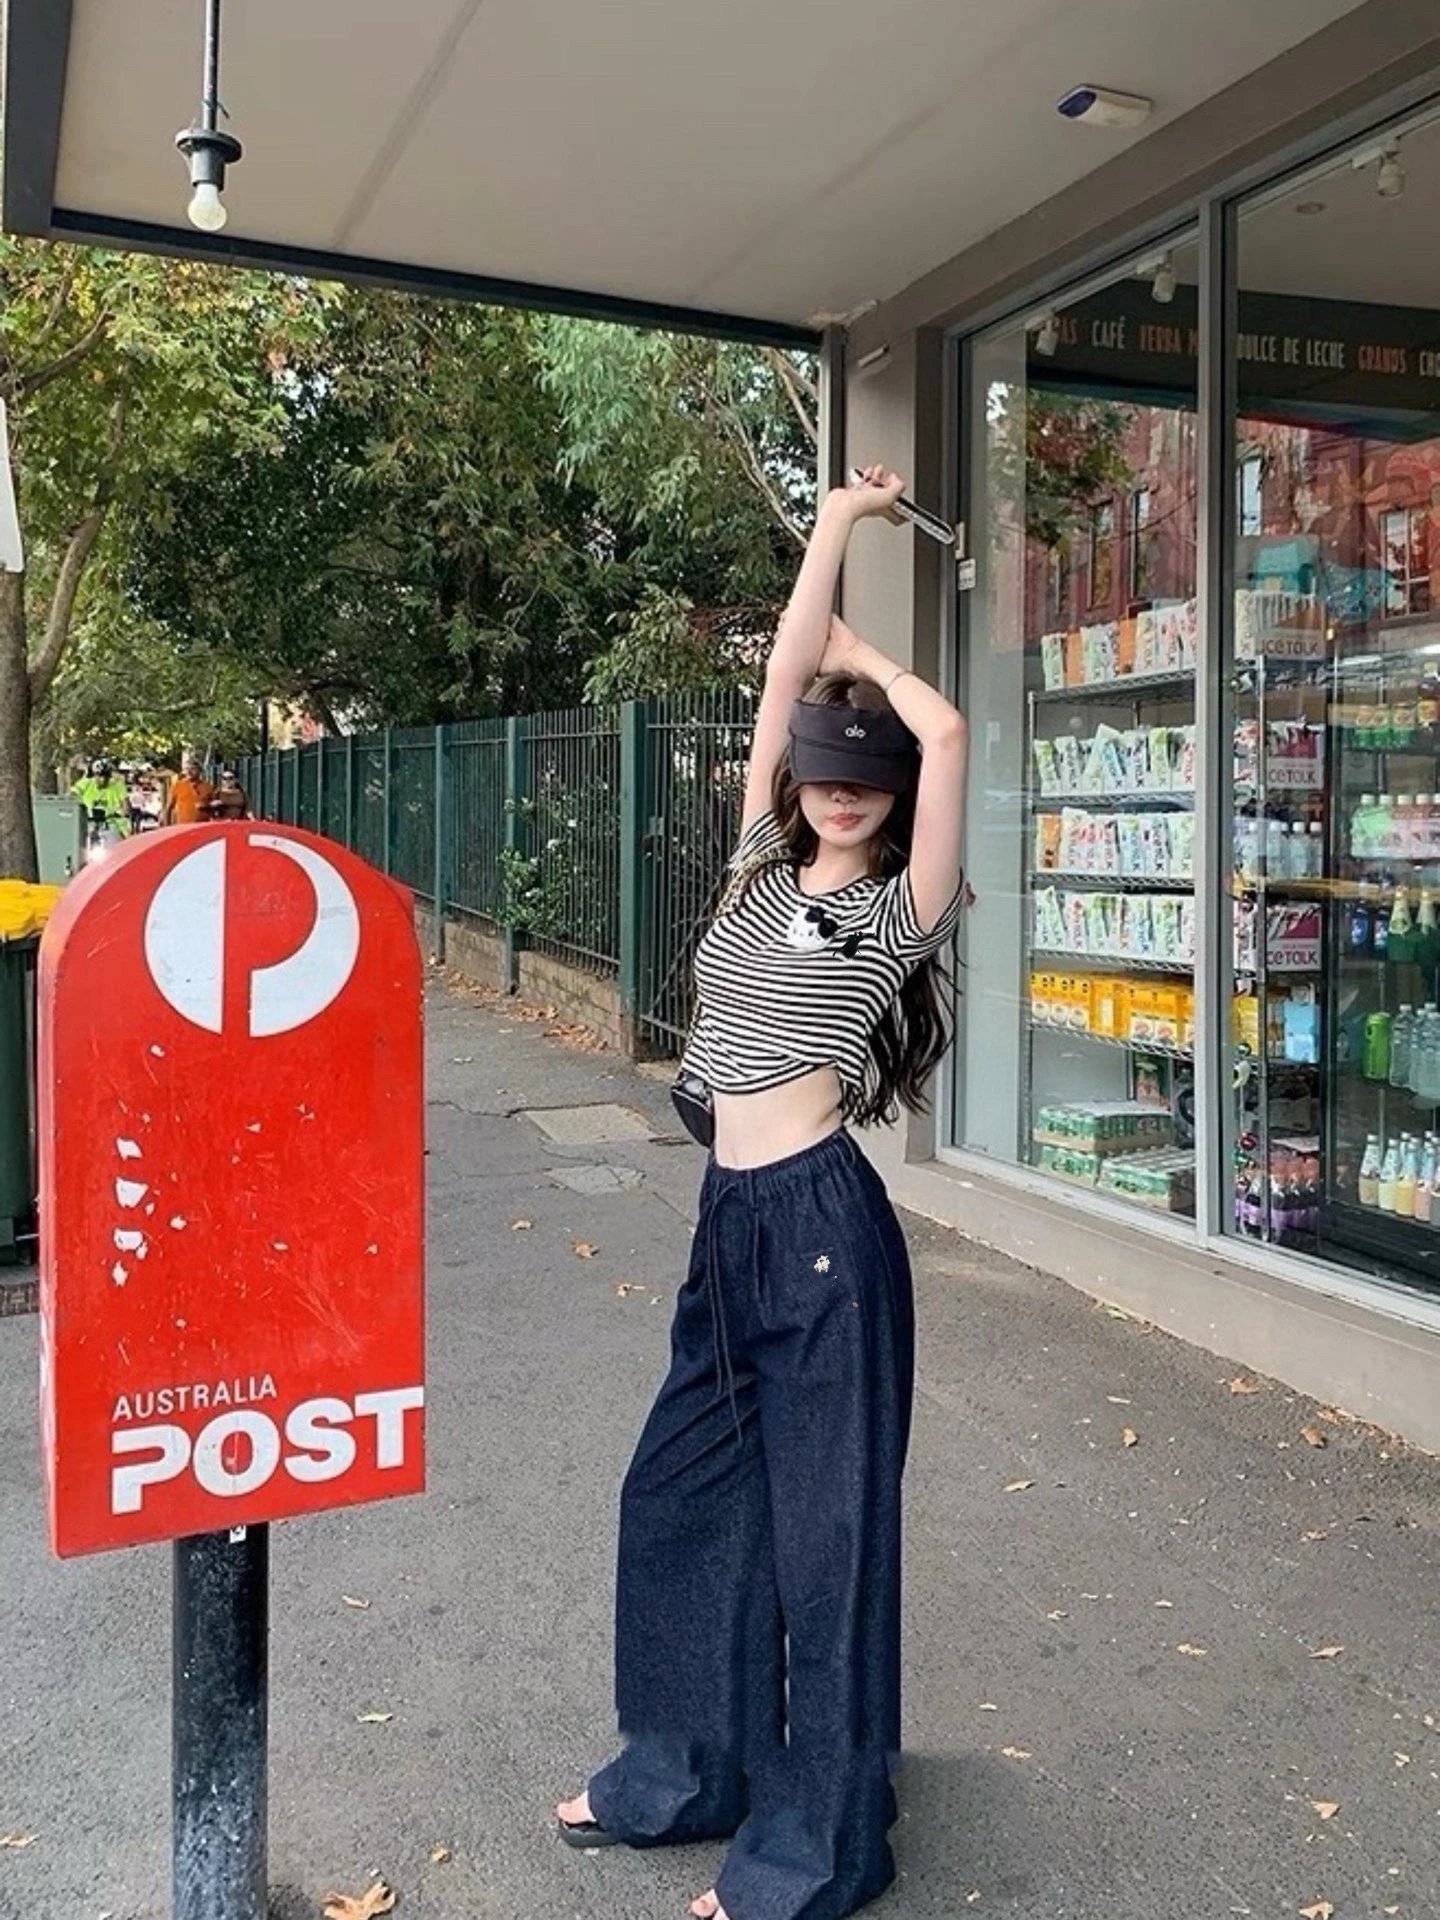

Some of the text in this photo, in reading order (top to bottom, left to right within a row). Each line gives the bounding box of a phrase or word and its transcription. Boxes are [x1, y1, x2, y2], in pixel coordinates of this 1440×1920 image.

[1091, 316, 1126, 350] CAFÉ
[1283, 336, 1300, 365] DE
[1306, 339, 1345, 369] LECHE
[845, 723, 867, 739] alo
[111, 1374, 278, 1423] AUSTRALIA
[110, 1386, 425, 1516] POST
